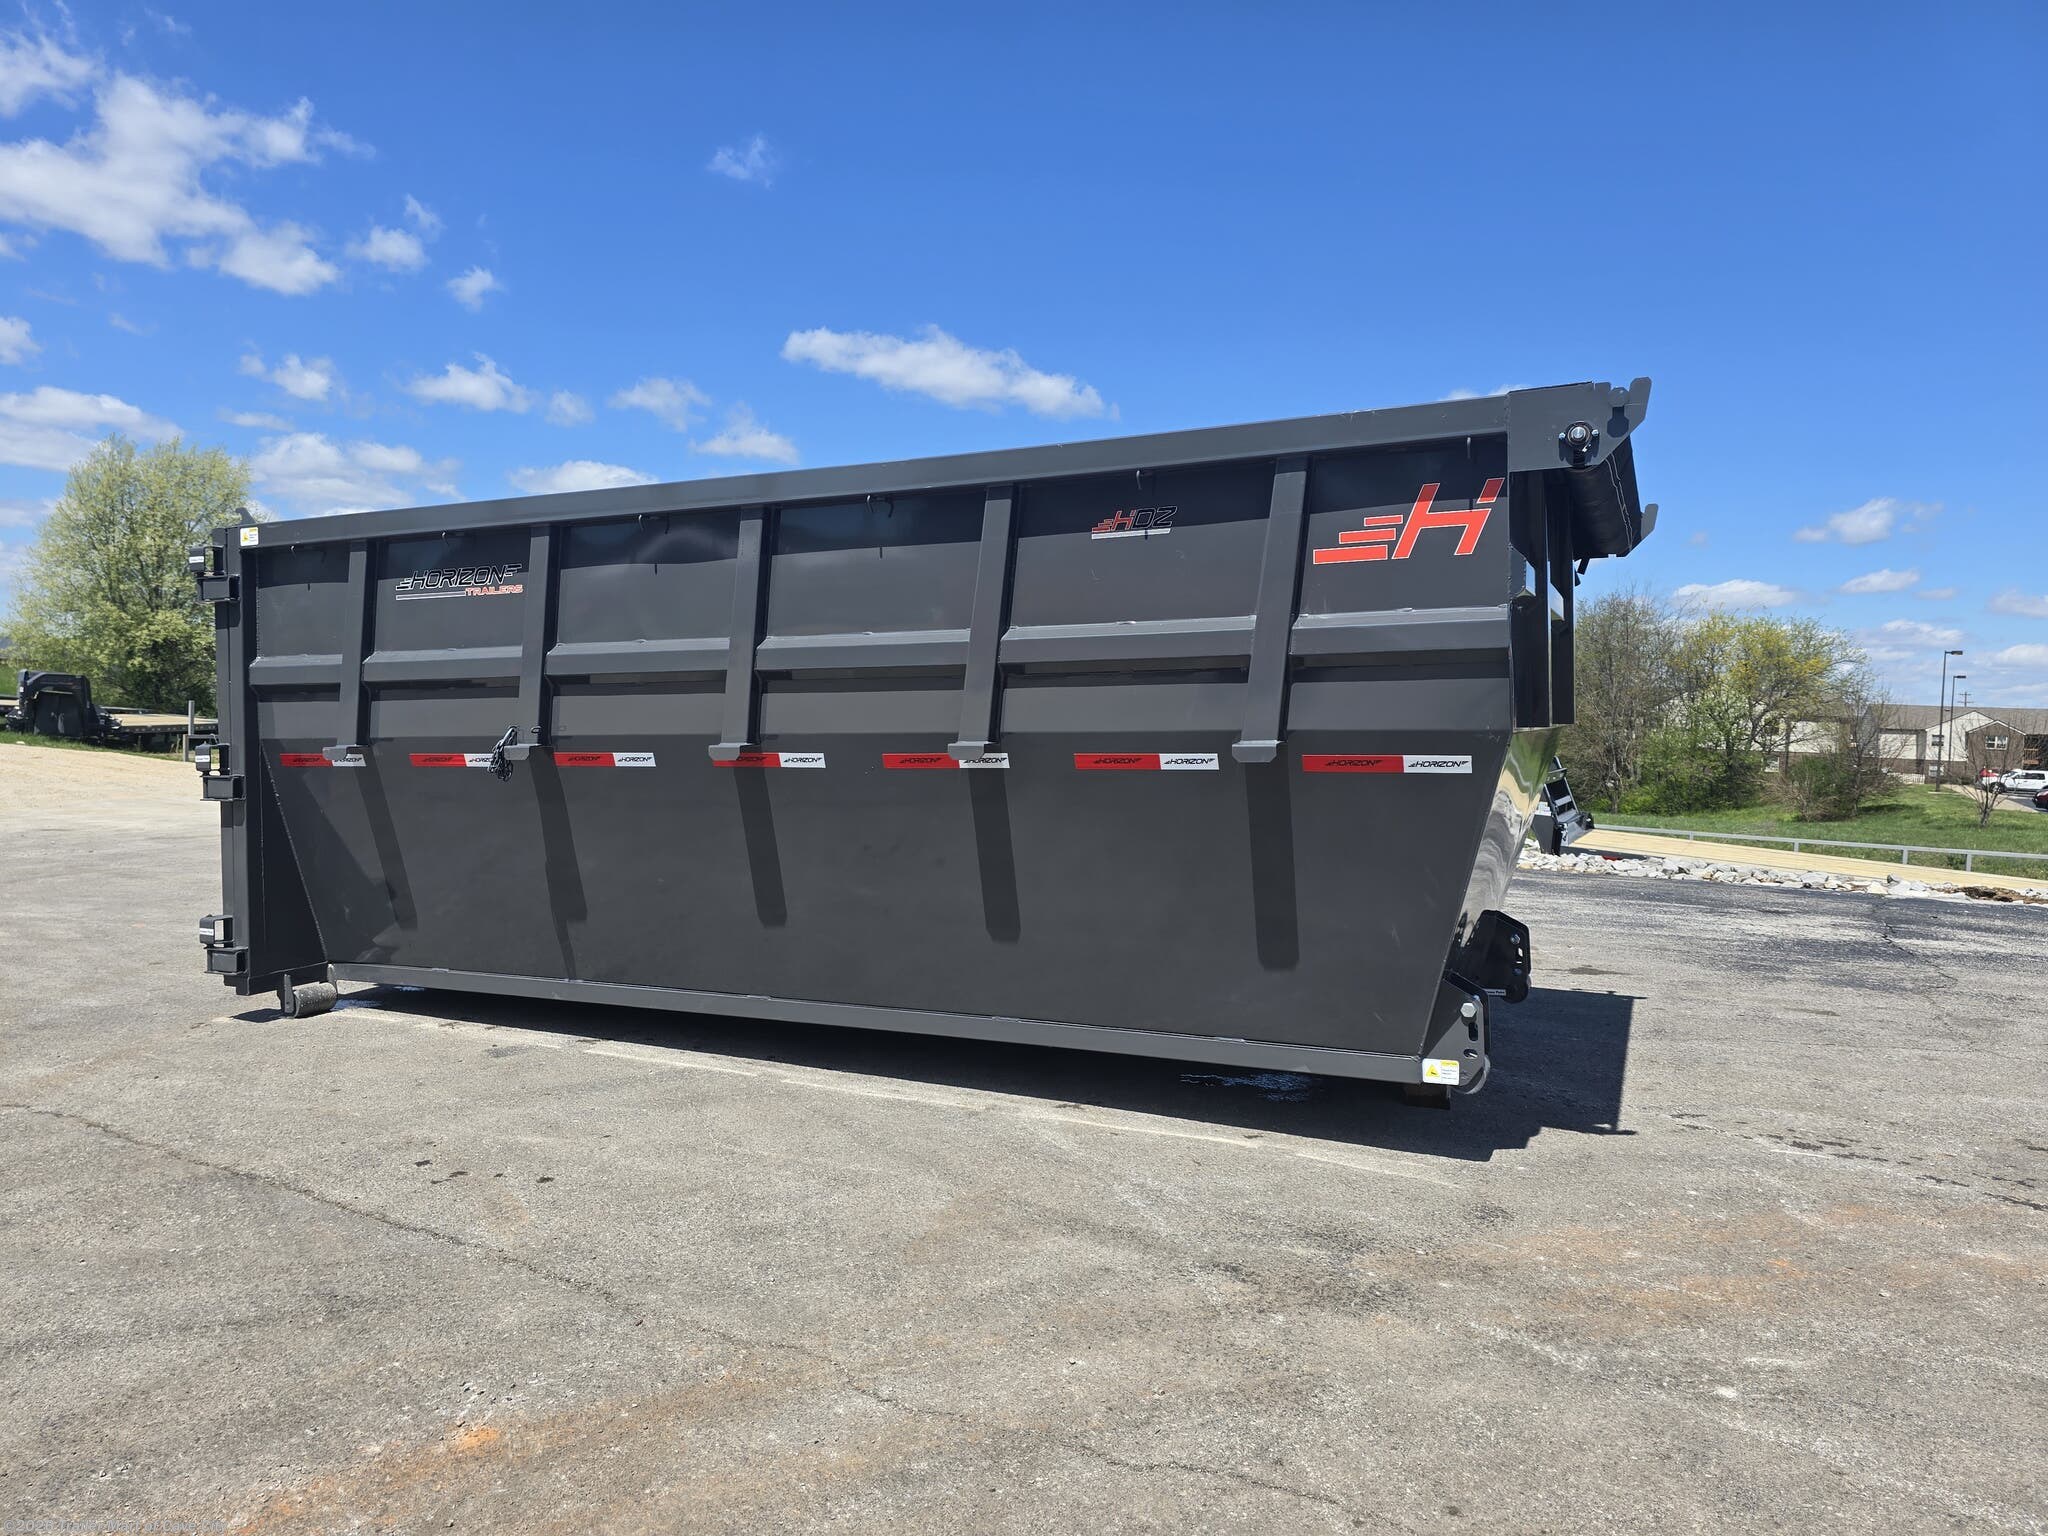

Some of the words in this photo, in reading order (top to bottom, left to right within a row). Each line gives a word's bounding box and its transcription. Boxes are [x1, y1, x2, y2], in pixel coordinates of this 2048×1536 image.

[401, 565, 517, 590] HORIZON
[465, 585, 523, 596] TRAILERS
[1326, 759, 1382, 767] HORIZON
[1409, 760, 1468, 768] HORIZON
